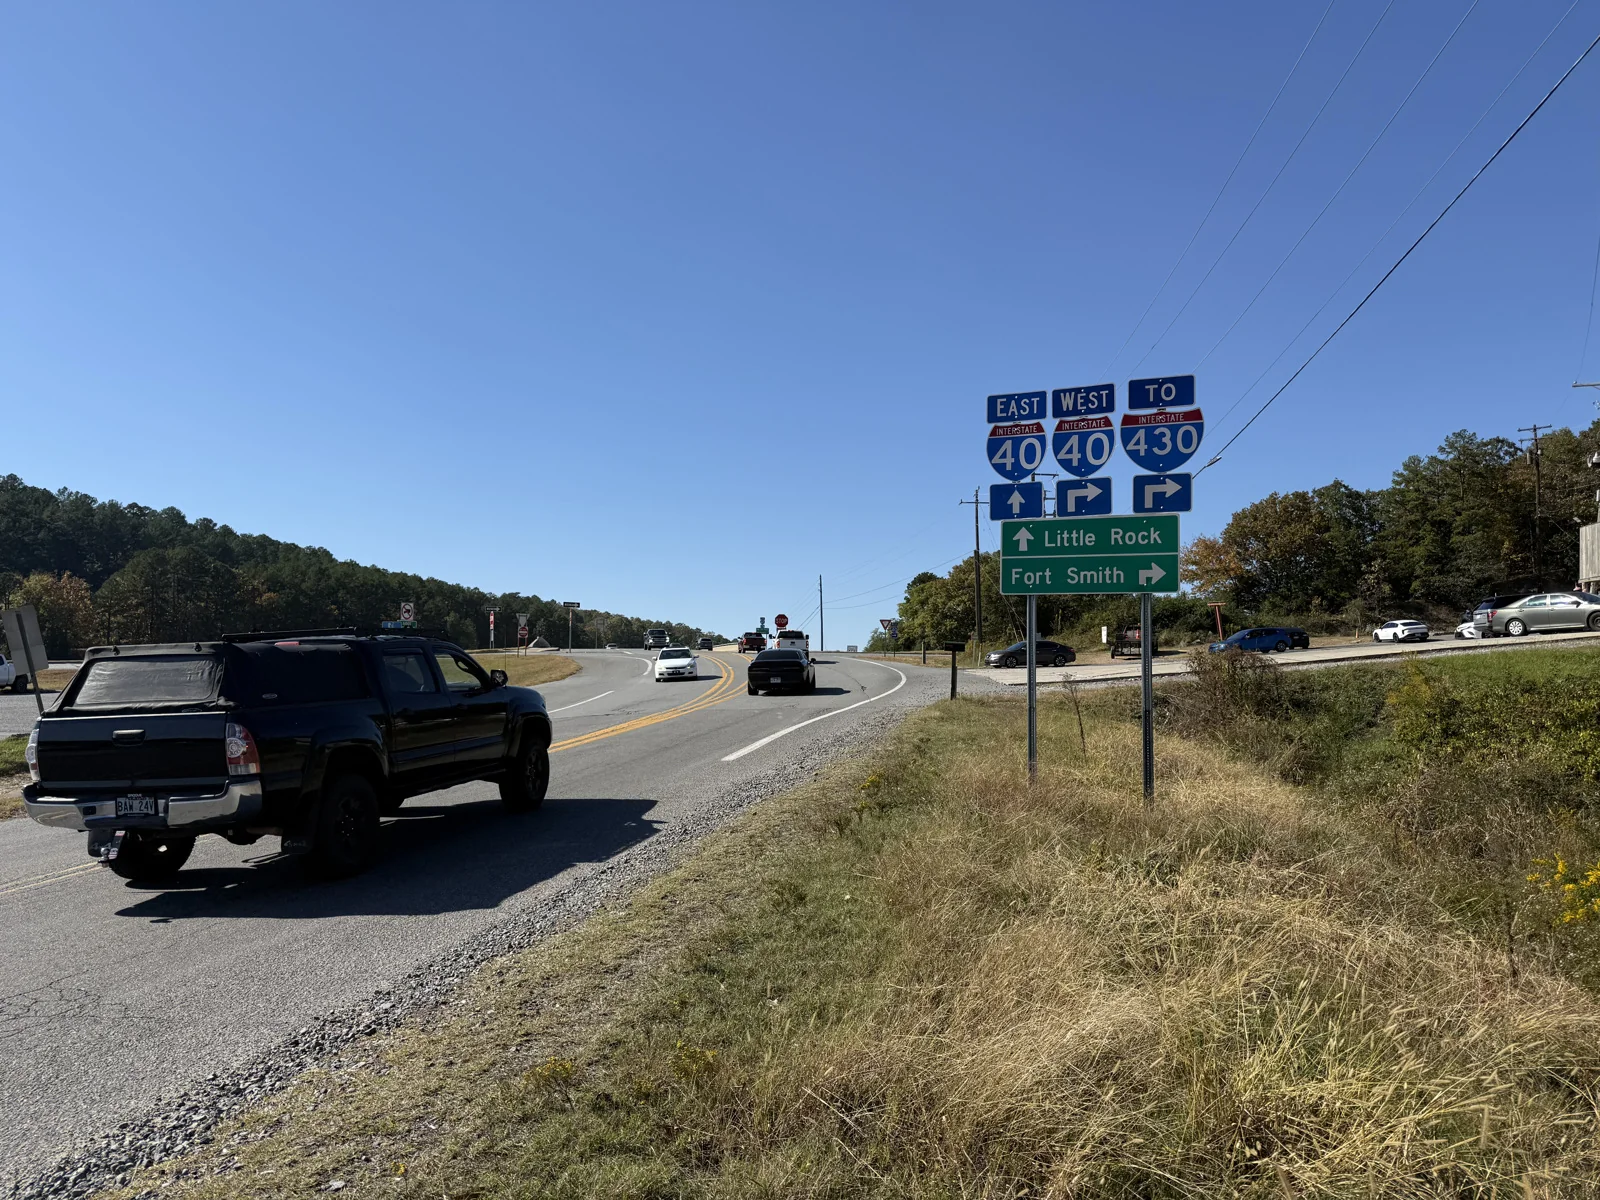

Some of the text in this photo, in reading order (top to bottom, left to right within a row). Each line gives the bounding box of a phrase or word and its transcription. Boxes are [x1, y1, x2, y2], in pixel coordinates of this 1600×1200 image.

[1060, 391, 1109, 412] WEST
[1145, 383, 1176, 402] TO
[996, 397, 1040, 417] EAST
[1062, 419, 1106, 430] INTERSTATE
[1138, 413, 1185, 423] INTERSTATE
[996, 425, 1038, 435] INTERSTATE
[1057, 432, 1110, 467] 40
[1126, 425, 1198, 456] 430
[991, 437, 1042, 471] 40
[1044, 527, 1162, 547] Little Rock
[1011, 566, 1124, 585] Fort Smith
[138, 800, 154, 812] 24V
